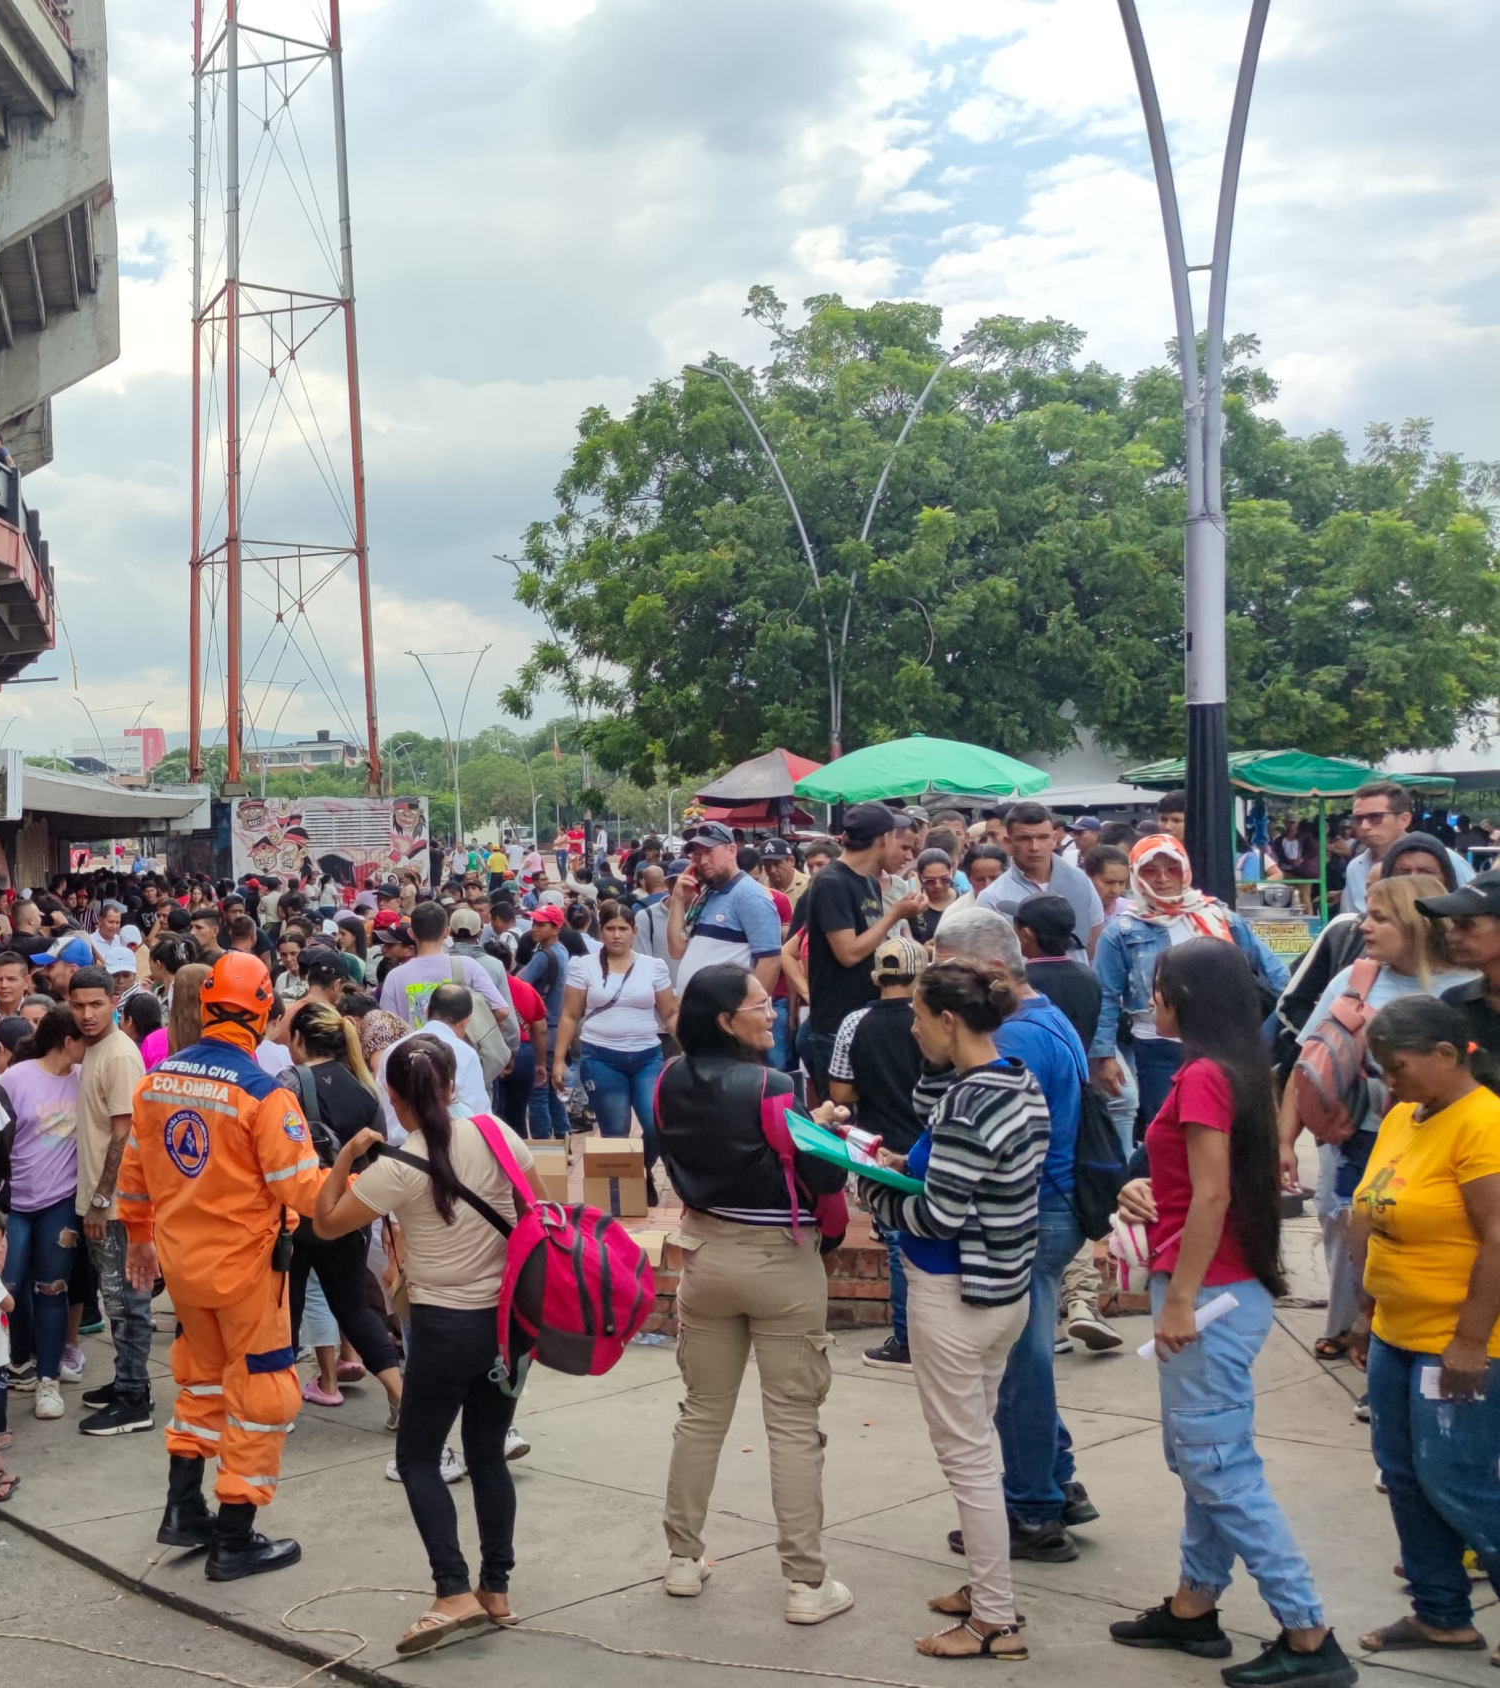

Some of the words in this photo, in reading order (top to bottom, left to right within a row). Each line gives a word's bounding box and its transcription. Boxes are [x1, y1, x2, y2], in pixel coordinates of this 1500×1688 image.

[160, 1060, 207, 1075] DEFENSA
[207, 1065, 239, 1083] CIVIL
[152, 1076, 229, 1103] COLOMBIA
